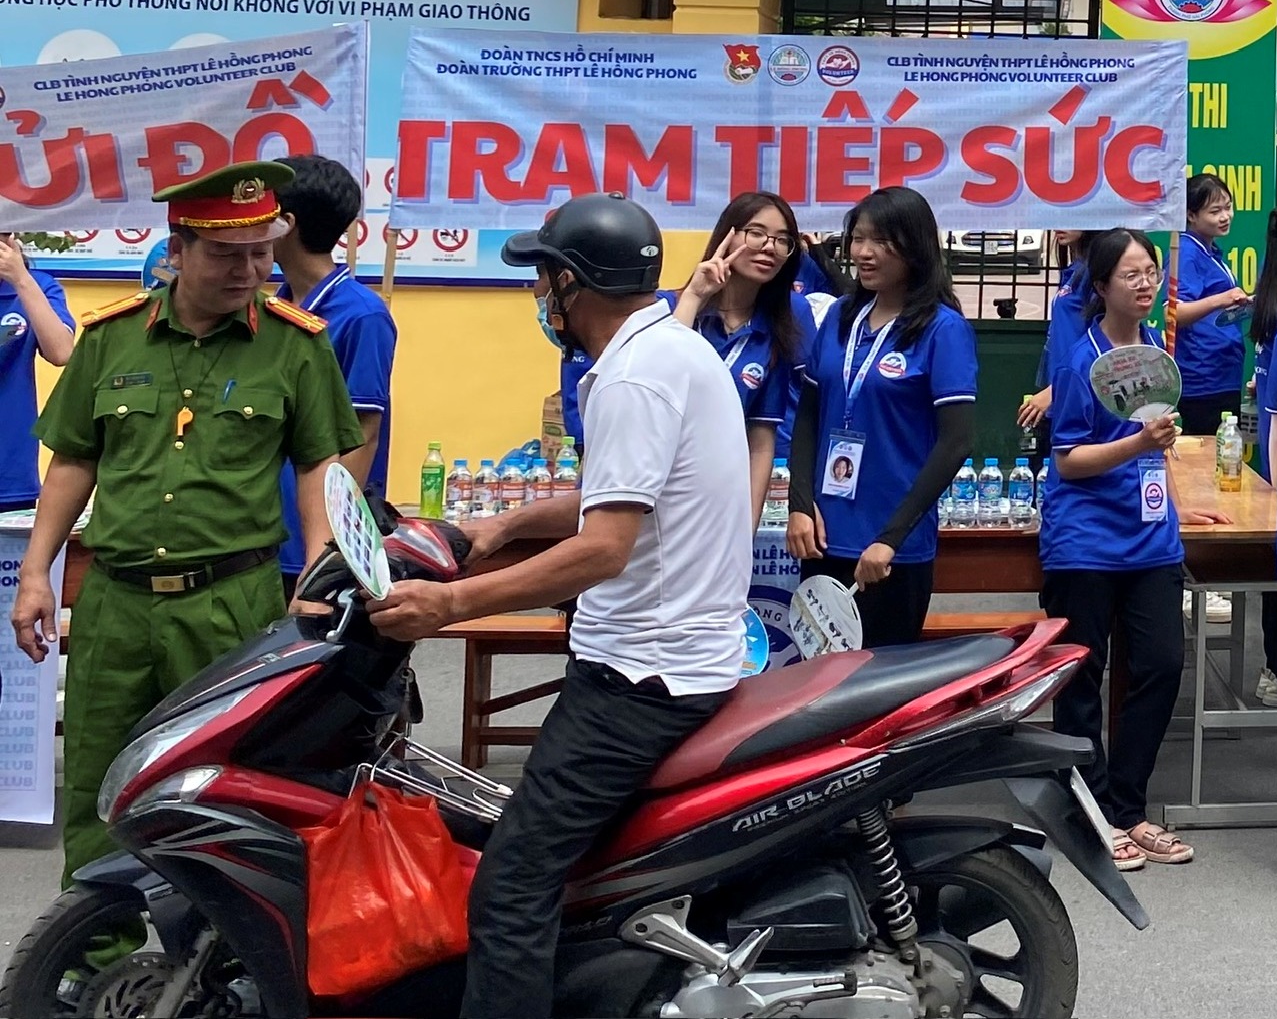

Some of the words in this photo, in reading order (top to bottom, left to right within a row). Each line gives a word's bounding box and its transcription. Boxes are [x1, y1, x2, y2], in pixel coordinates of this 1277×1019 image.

[339, 0, 356, 16] VI
[360, 2, 413, 22] PHẠM
[418, 3, 463, 19] GIAO
[467, 1, 531, 21] THÔNG
[480, 46, 524, 62] ĐOÀN
[526, 51, 562, 62] TNCS
[564, 44, 587, 63] HỒ
[588, 47, 614, 63] CHÍ
[616, 52, 655, 64] MINH
[887, 56, 911, 67] CLB
[912, 53, 944, 67] TÌNH
[946, 53, 999, 71] NGUYỆN
[1000, 58, 1034, 68] THPT
[1034, 54, 1049, 68] LÊ
[1050, 51, 1088, 69] HỒNG
[1089, 58, 1135, 69] PHONG
[34, 79, 60, 91] CLB
[61, 73, 99, 90] TÌNH
[100, 66, 162, 86] NGUYỆN
[161, 62, 199, 78] THPT
[201, 58, 219, 72] LÊ
[218, 52, 262, 70] HỒNG
[262, 46, 313, 64] PHONG
[436, 60, 481, 76] ĐOÀN
[482, 64, 542, 78] TRƯỜNG
[545, 66, 582, 78] THPT
[583, 63, 600, 78] LÊ
[646, 67, 697, 80] PHONG
[904, 71, 920, 81] LE
[920, 71, 959, 82] HONG
[960, 72, 1009, 82] PHONG
[1010, 72, 1084, 82] VOLUNTEER
[1085, 72, 1117, 82] CLUB
[56, 91, 77, 103] LE
[76, 86, 120, 100] HONG
[120, 81, 174, 95] PHONG
[174, 68, 260, 91] VOLUNTEER
[260, 61, 296, 76] CLUB
[1189, 83, 1228, 128] THI
[714, 87, 946, 204] TIẾP
[960, 84, 1165, 205] SỨC
[762, 561, 777, 575] LÊ
[732, 805, 779, 832] AIR
[787, 761, 881, 810] BLADE
